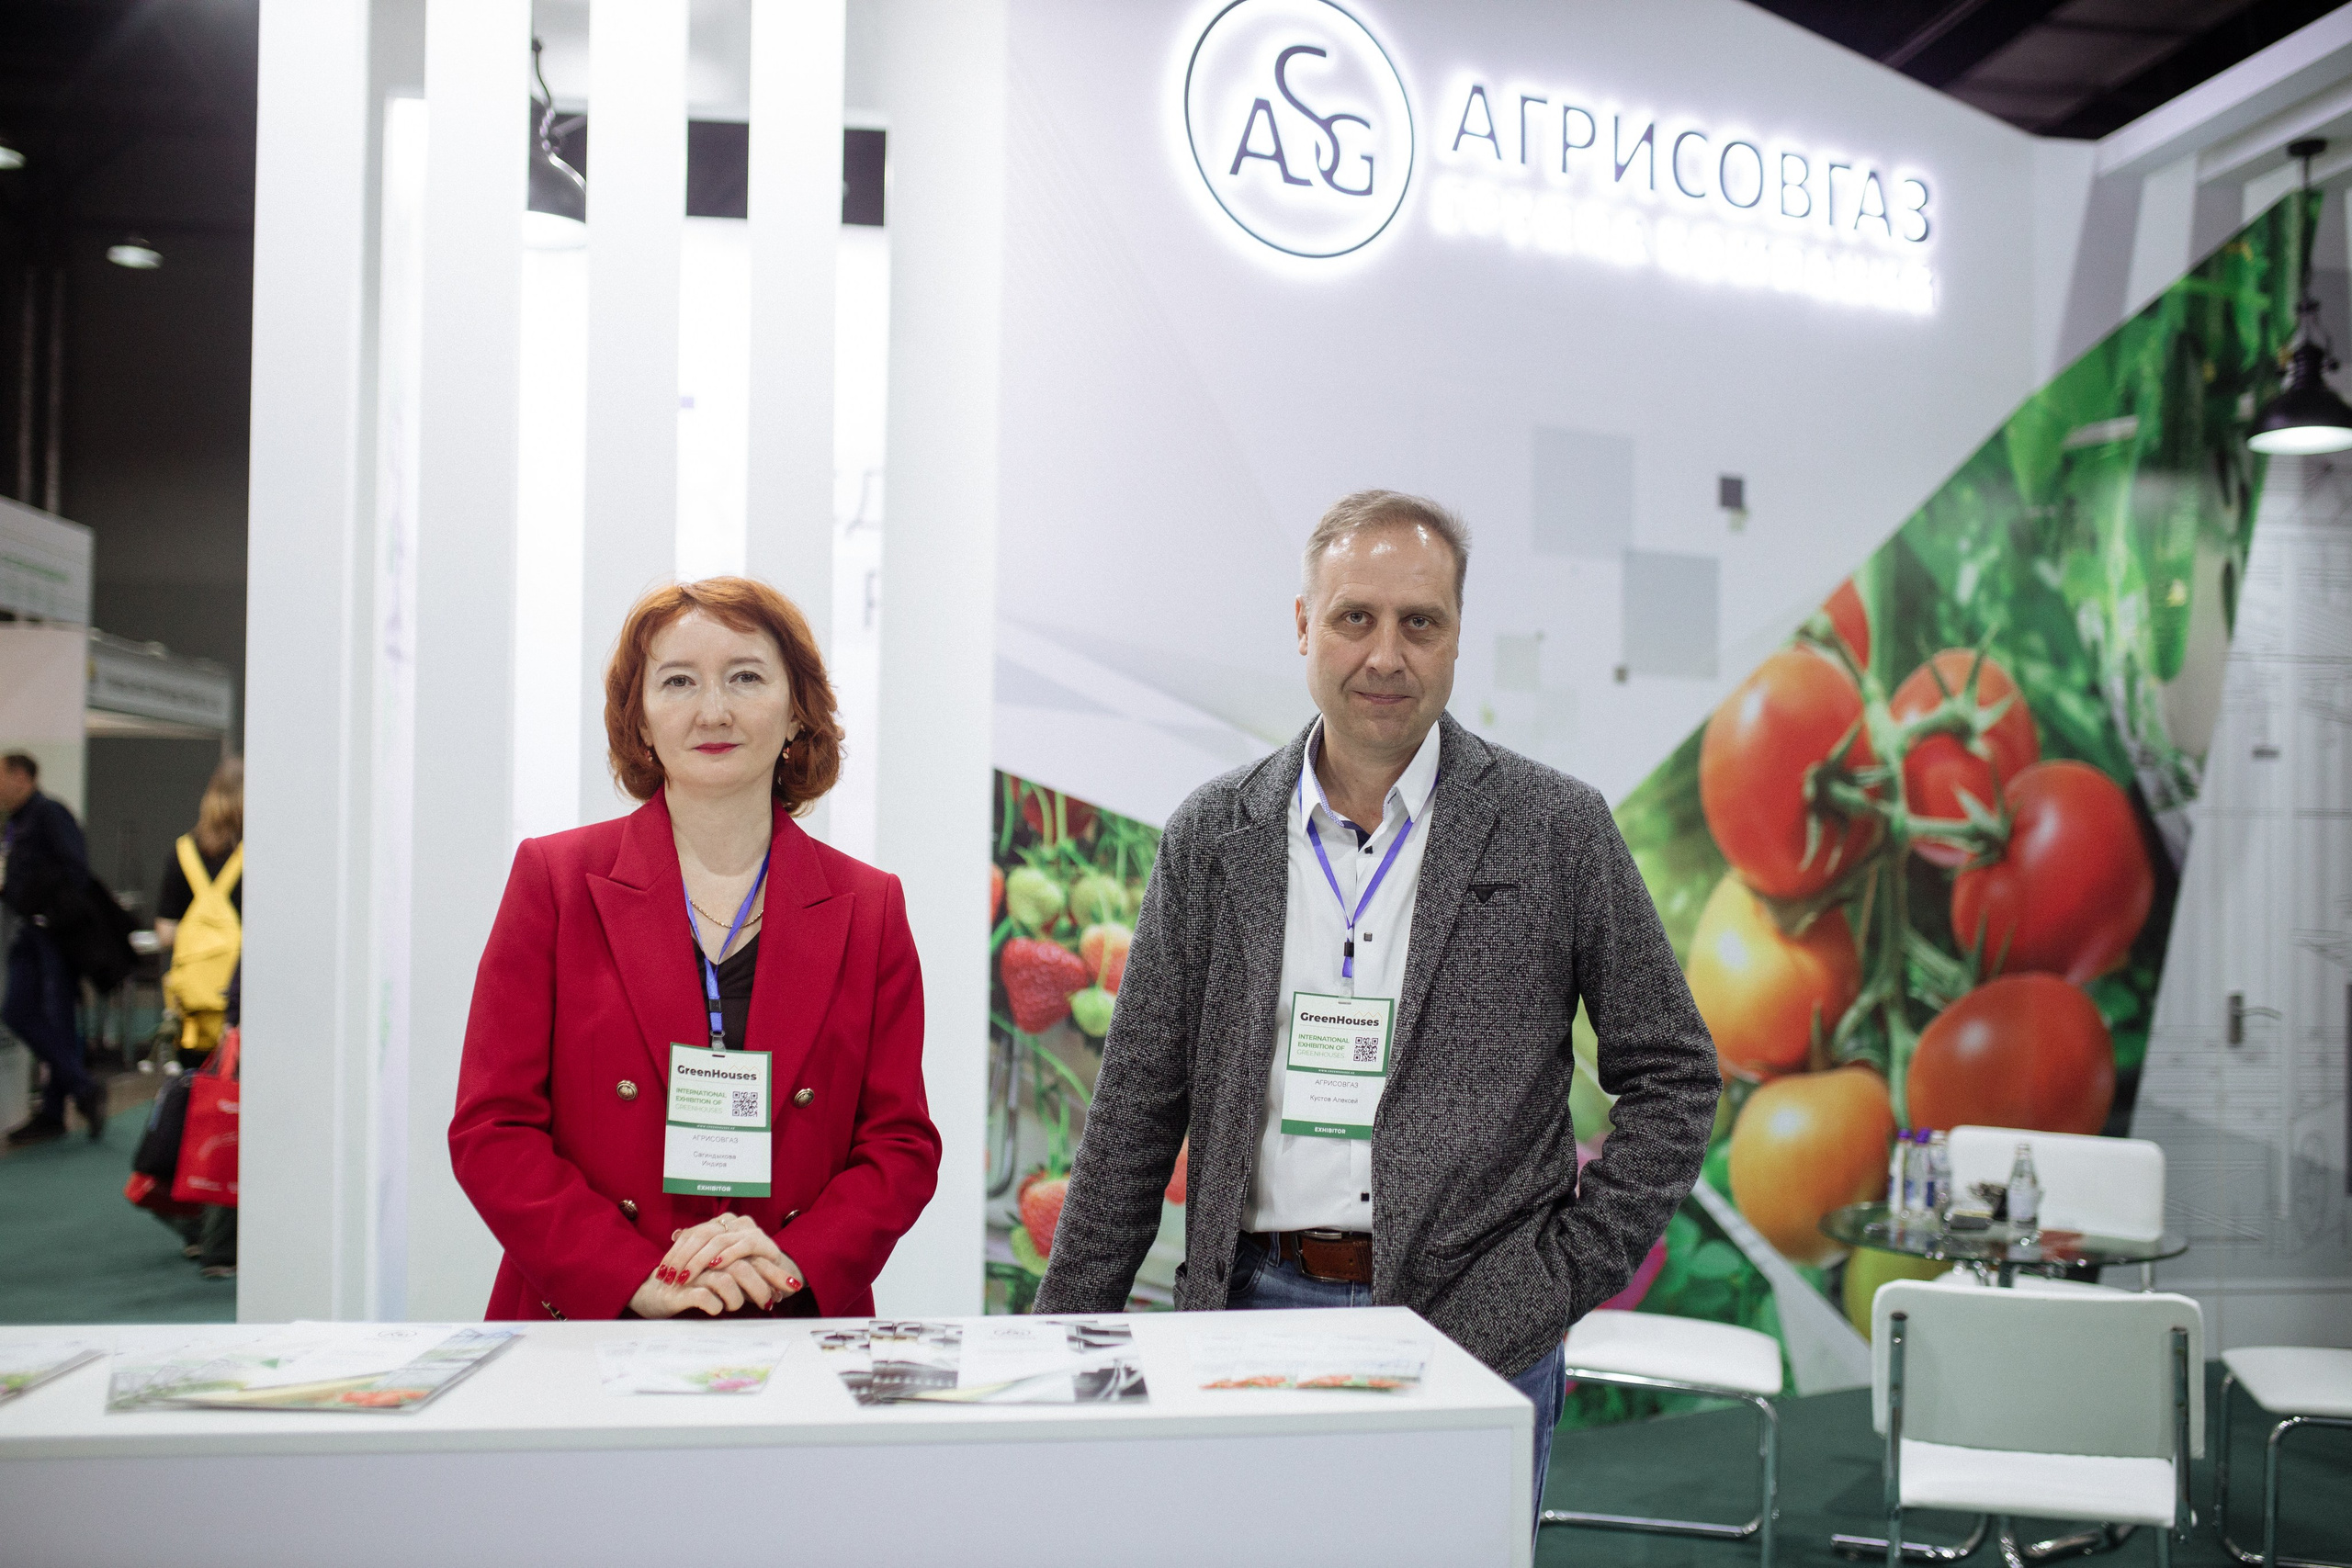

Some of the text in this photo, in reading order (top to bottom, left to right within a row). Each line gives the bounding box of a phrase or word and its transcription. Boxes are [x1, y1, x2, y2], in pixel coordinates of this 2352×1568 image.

[1452, 85, 1928, 243] АГРИСОВГАЗ
[1300, 1011, 1380, 1026] GreenHouses
[1297, 1033, 1350, 1043] INTERNATIONAL
[1297, 1042, 1334, 1050] EXHIBITION
[1296, 1049, 1345, 1058] GREENHOUSES
[676, 1065, 758, 1080] GreenHouses
[1315, 1079, 1358, 1088] АГРИСОВГАЗ
[675, 1087, 726, 1098] INTERNATIONAL
[675, 1095, 711, 1105] EXHIBITION
[674, 1103, 723, 1113] GREENHOUSES
[692, 1134, 738, 1144] АГРИСОВГАЗ
